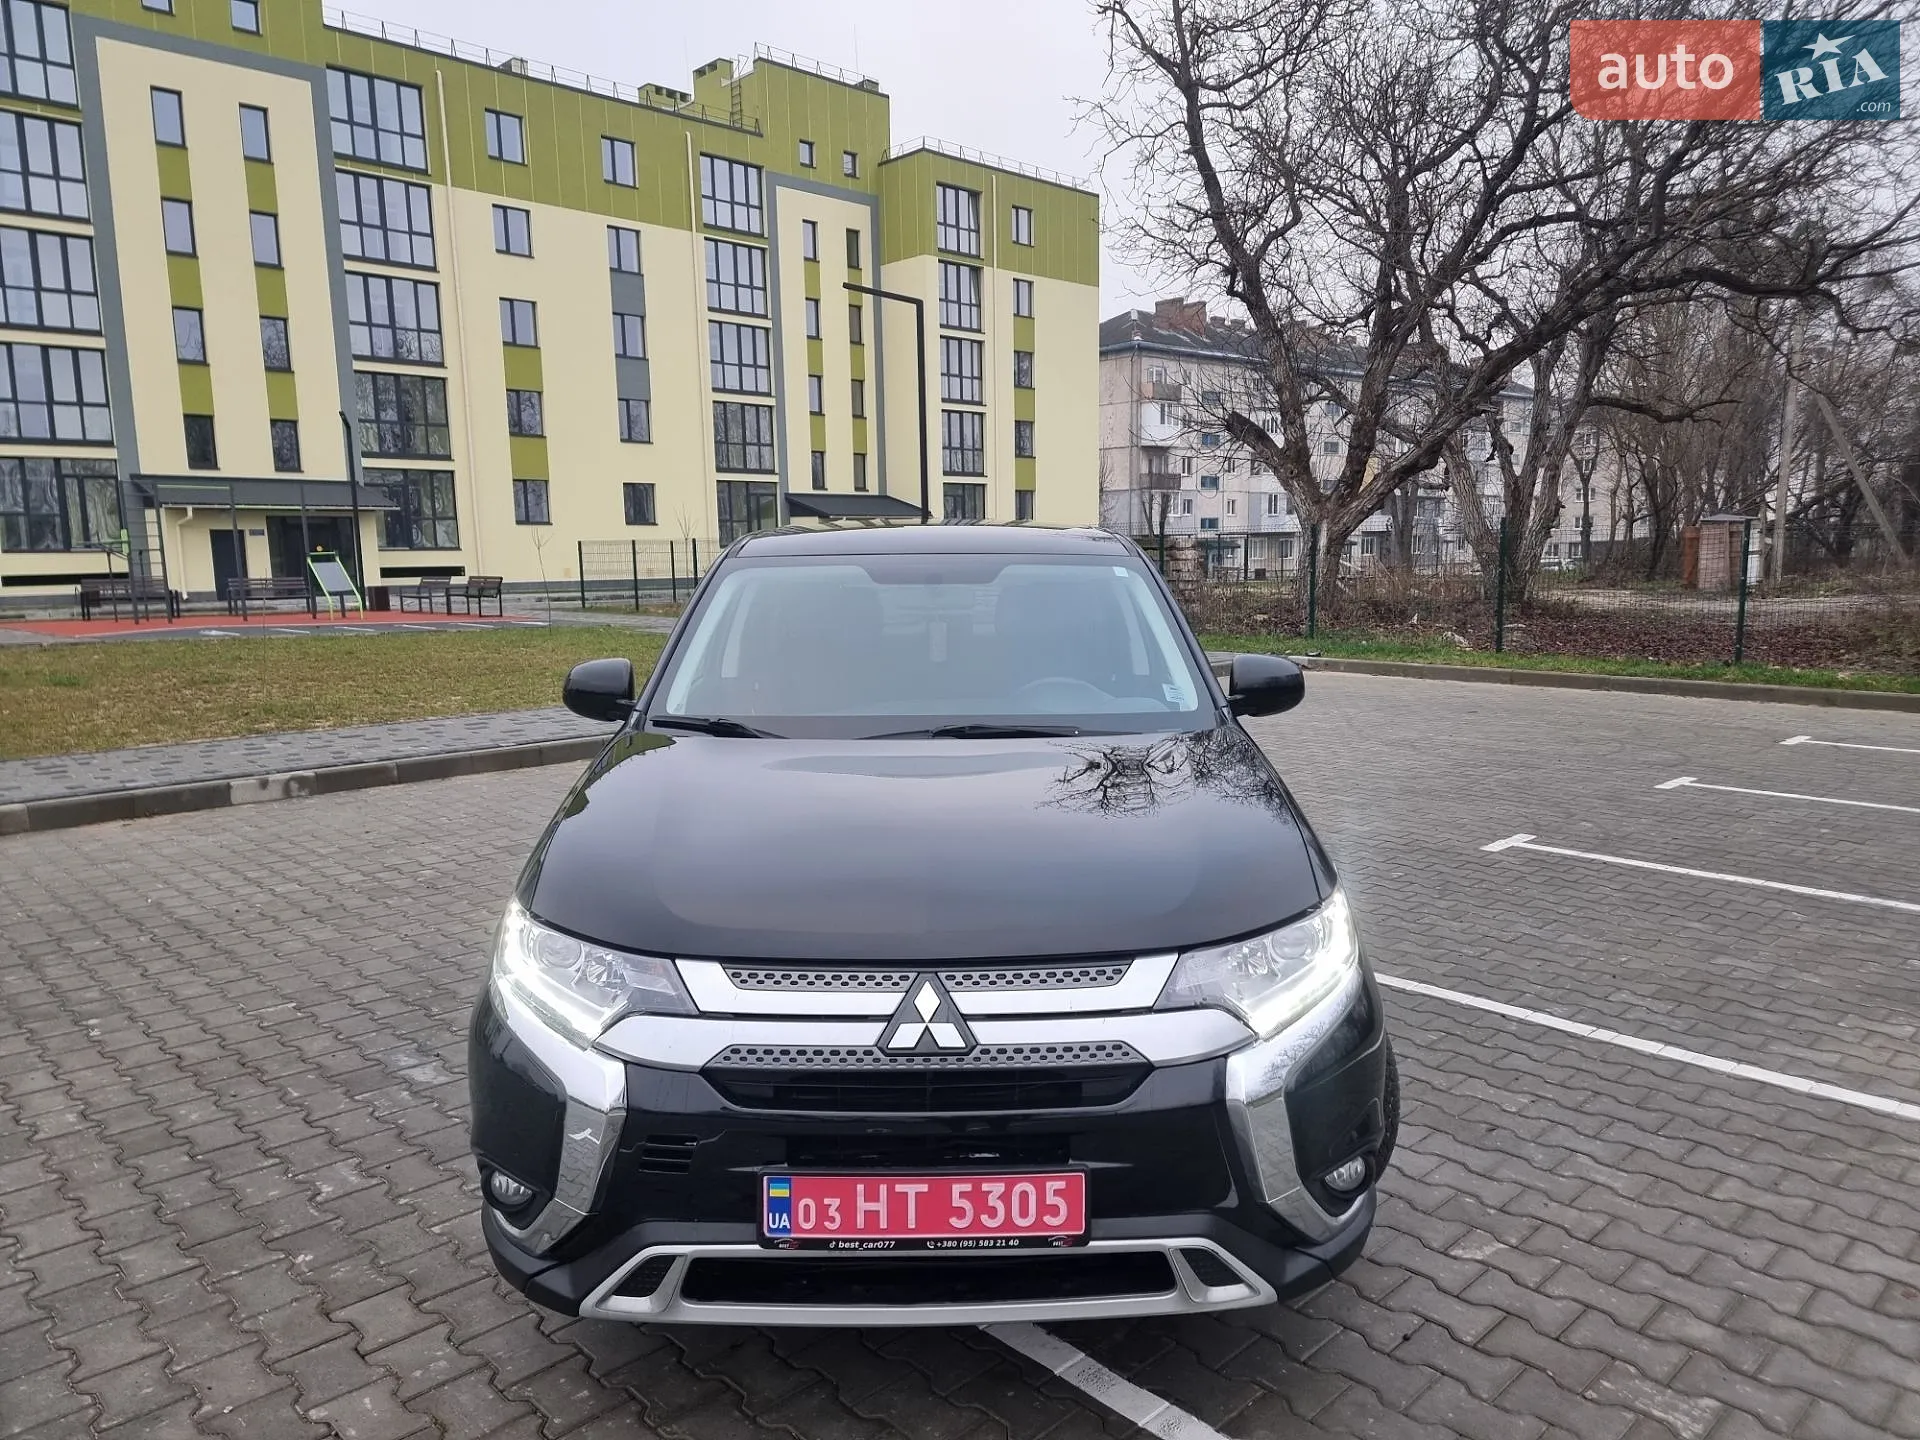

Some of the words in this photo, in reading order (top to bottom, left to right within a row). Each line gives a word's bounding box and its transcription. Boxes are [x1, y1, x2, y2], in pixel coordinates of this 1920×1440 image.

[797, 1198, 841, 1230] 03
[856, 1183, 929, 1229] HT
[948, 1181, 1068, 1229] 5305
[768, 1212, 791, 1229] UA
[838, 1240, 896, 1250] best_car077
[936, 1240, 957, 1248] +380
[959, 1239, 976, 1248] (95)
[995, 1239, 1006, 1247] 21
[1008, 1239, 1020, 1247] 40
